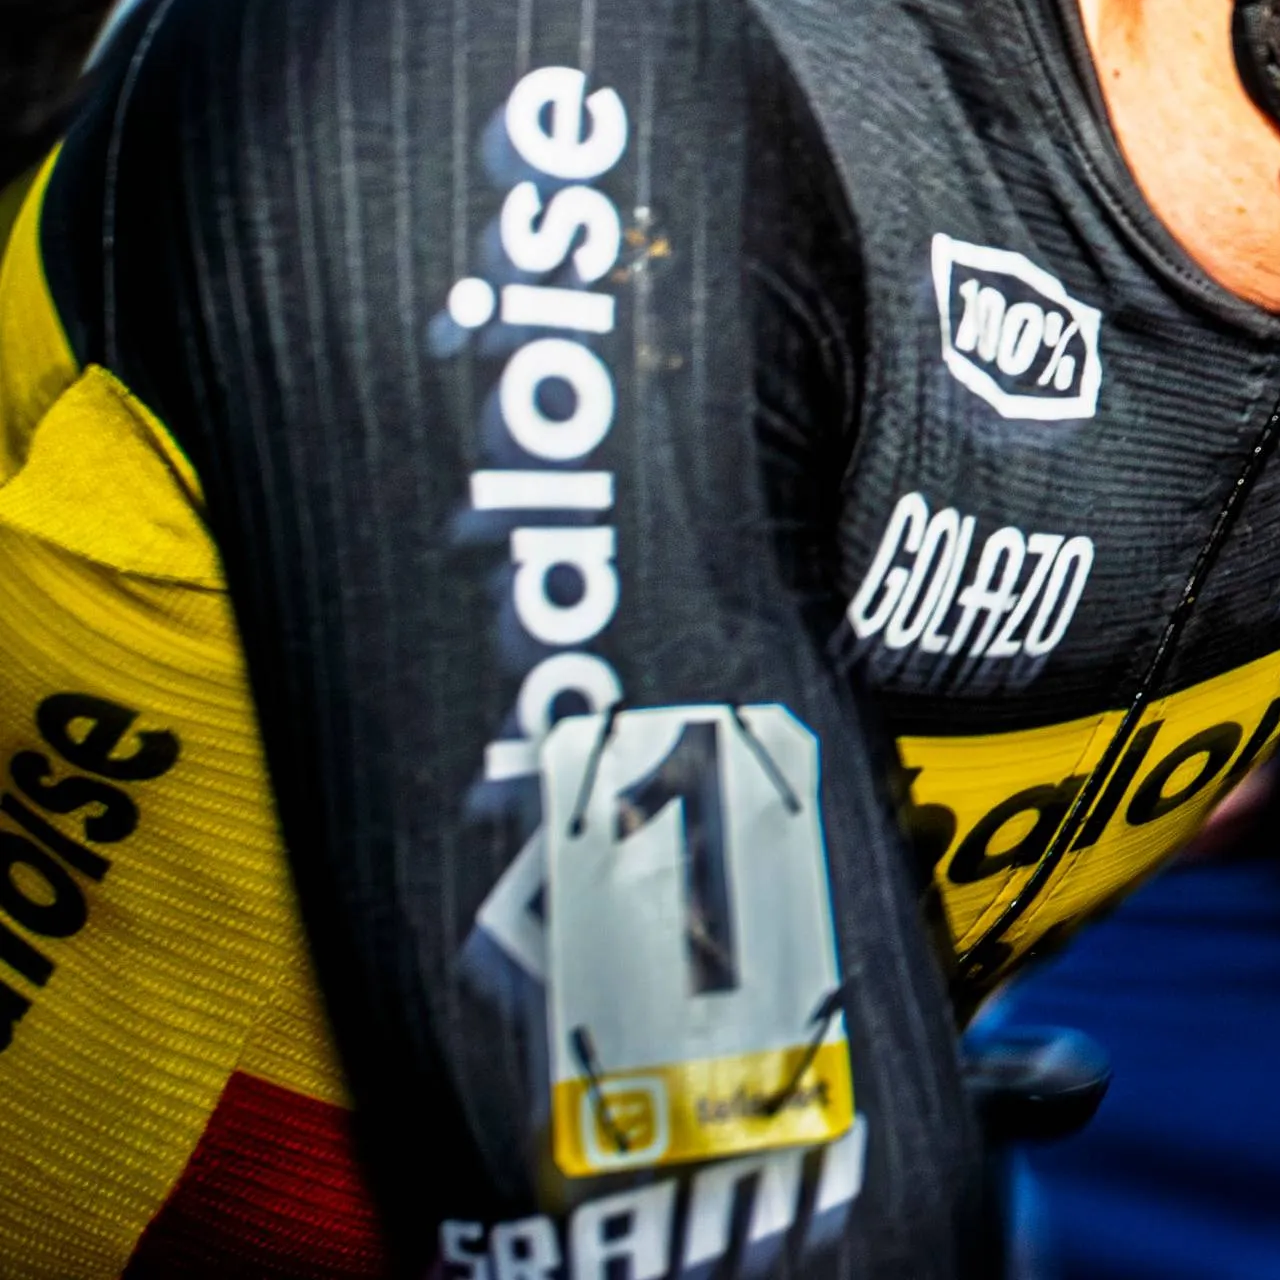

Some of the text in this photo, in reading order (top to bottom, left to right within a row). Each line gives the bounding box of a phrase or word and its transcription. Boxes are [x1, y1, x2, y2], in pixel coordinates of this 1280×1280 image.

[447, 66, 626, 782] baloise
[957, 282, 1076, 392] 100%
[849, 493, 1094, 658] GOLAZO
[613, 721, 739, 997] 1
